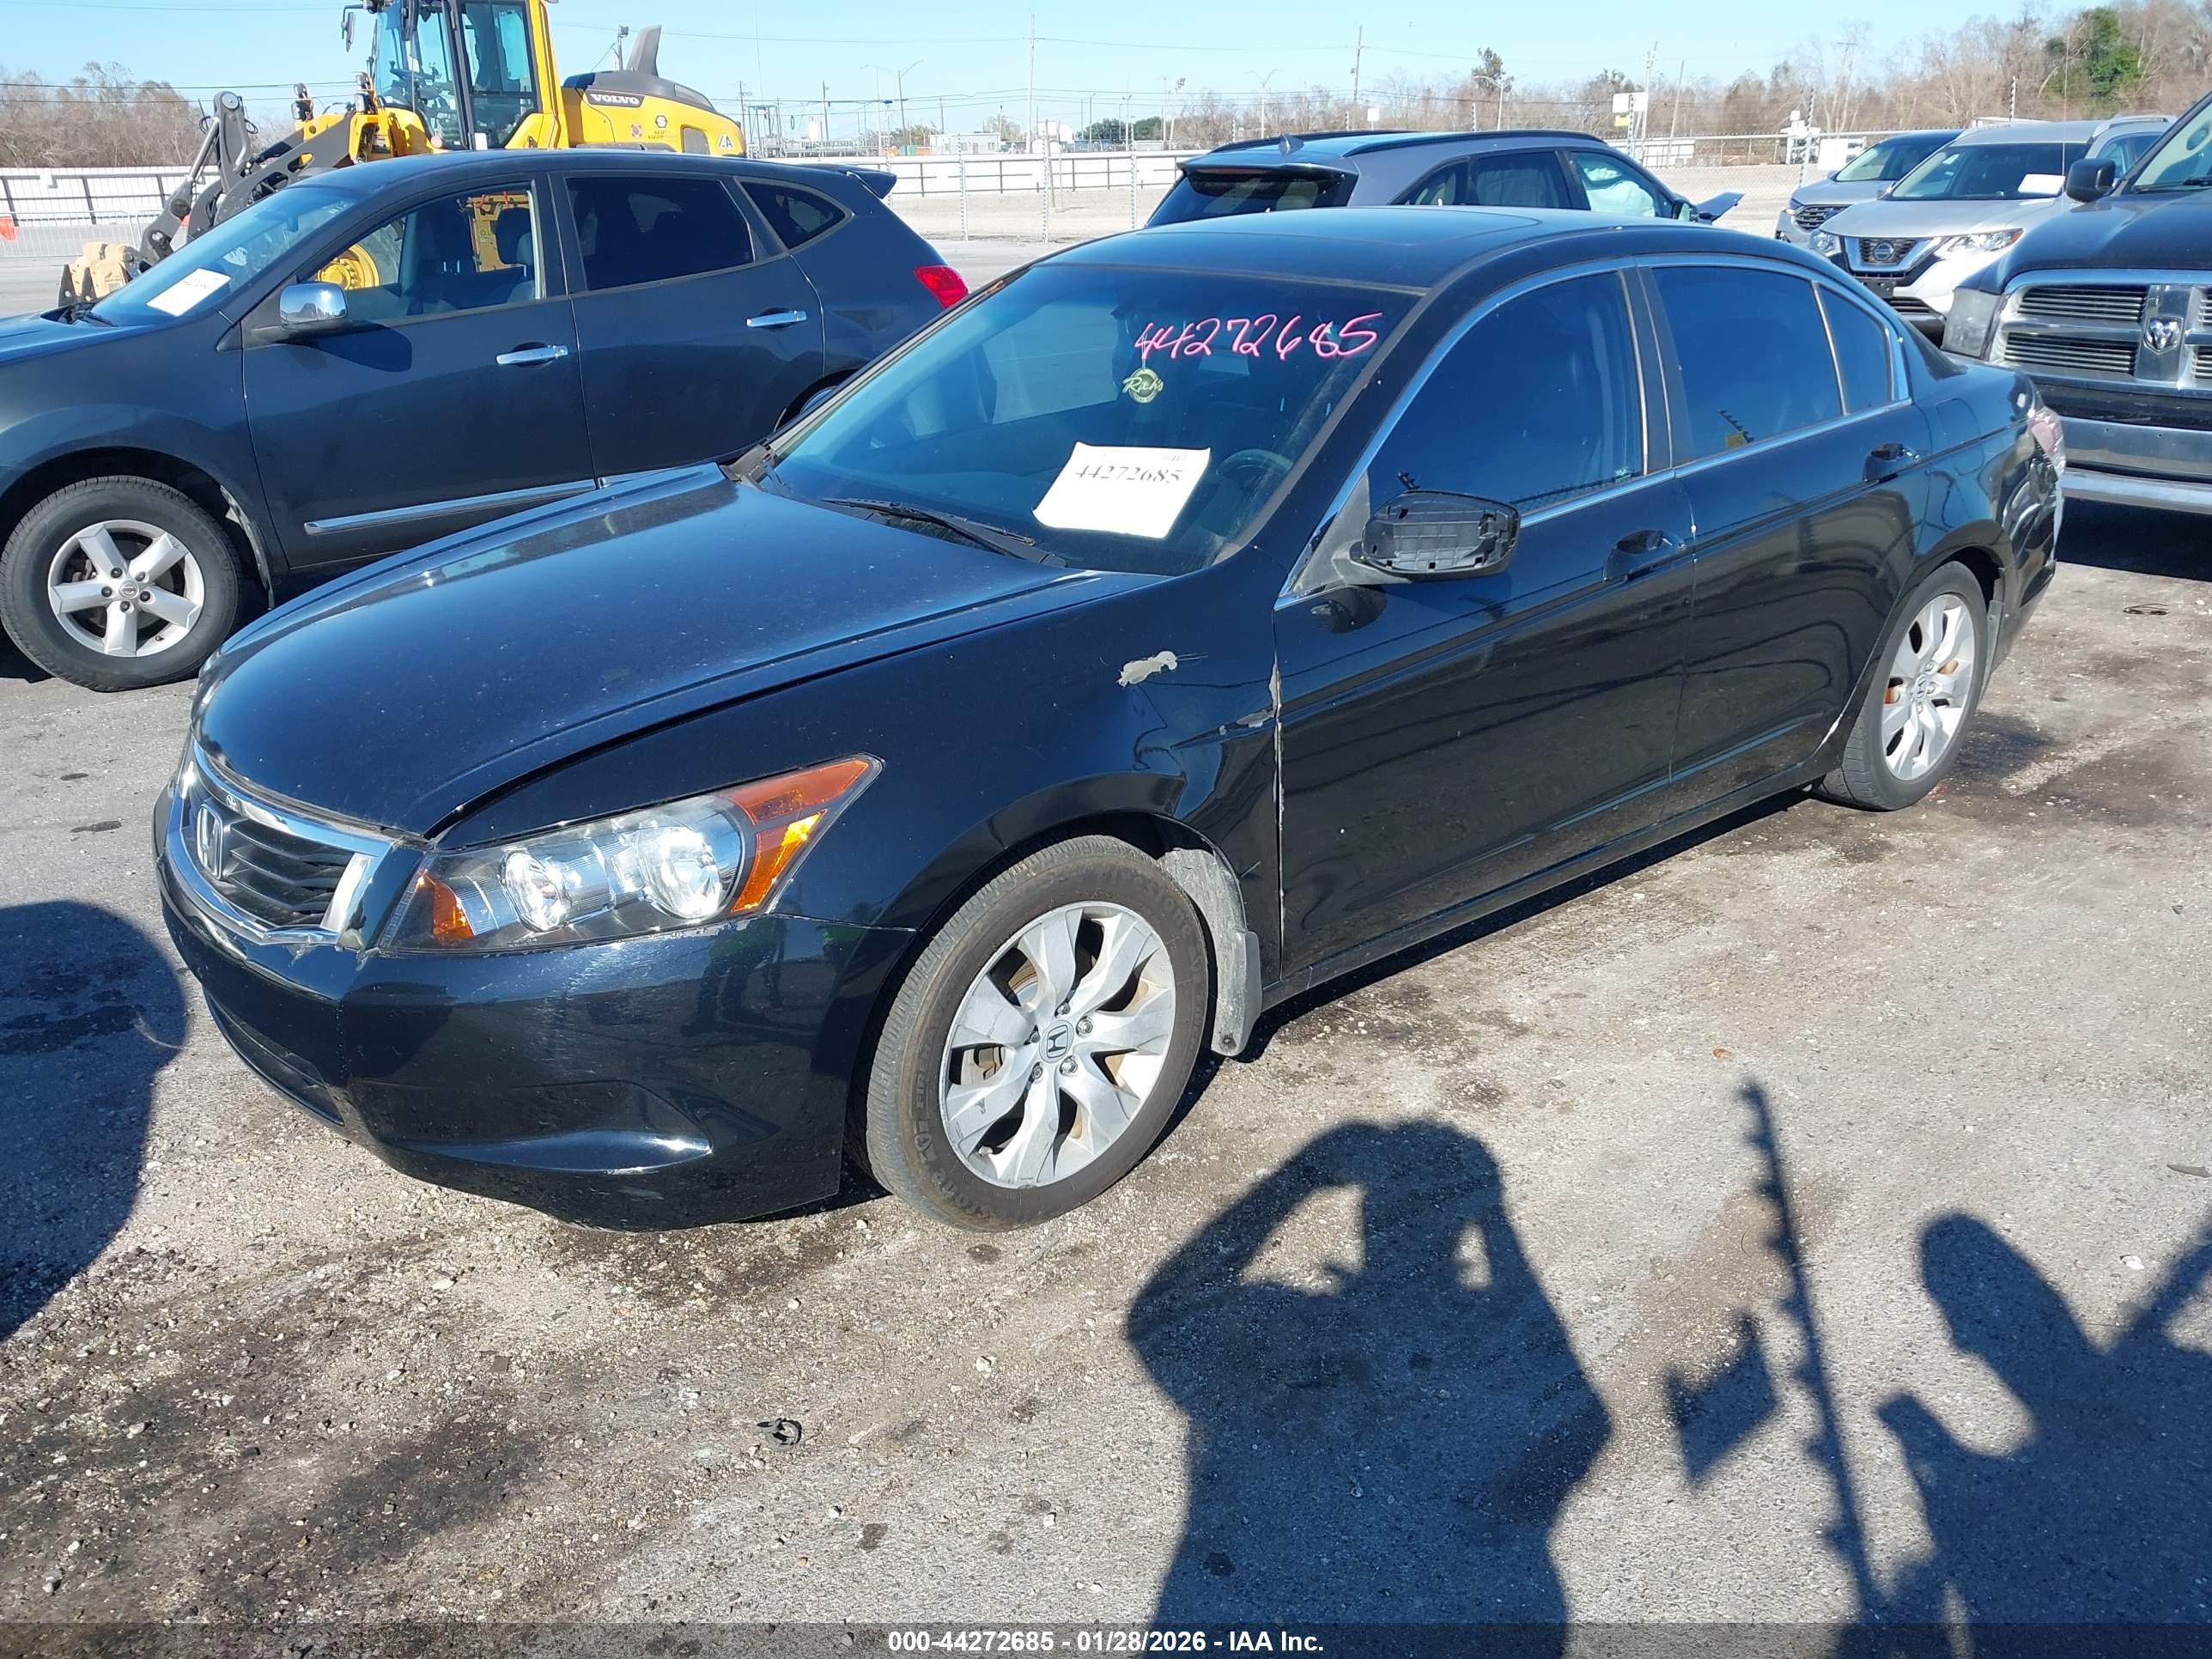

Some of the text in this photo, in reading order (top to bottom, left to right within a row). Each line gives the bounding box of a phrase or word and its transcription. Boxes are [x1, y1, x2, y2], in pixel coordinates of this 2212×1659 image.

[589, 93, 640, 105] VOLVO
[1133, 312, 1383, 361] 44272685
[1075, 465, 1183, 484] 44272685
